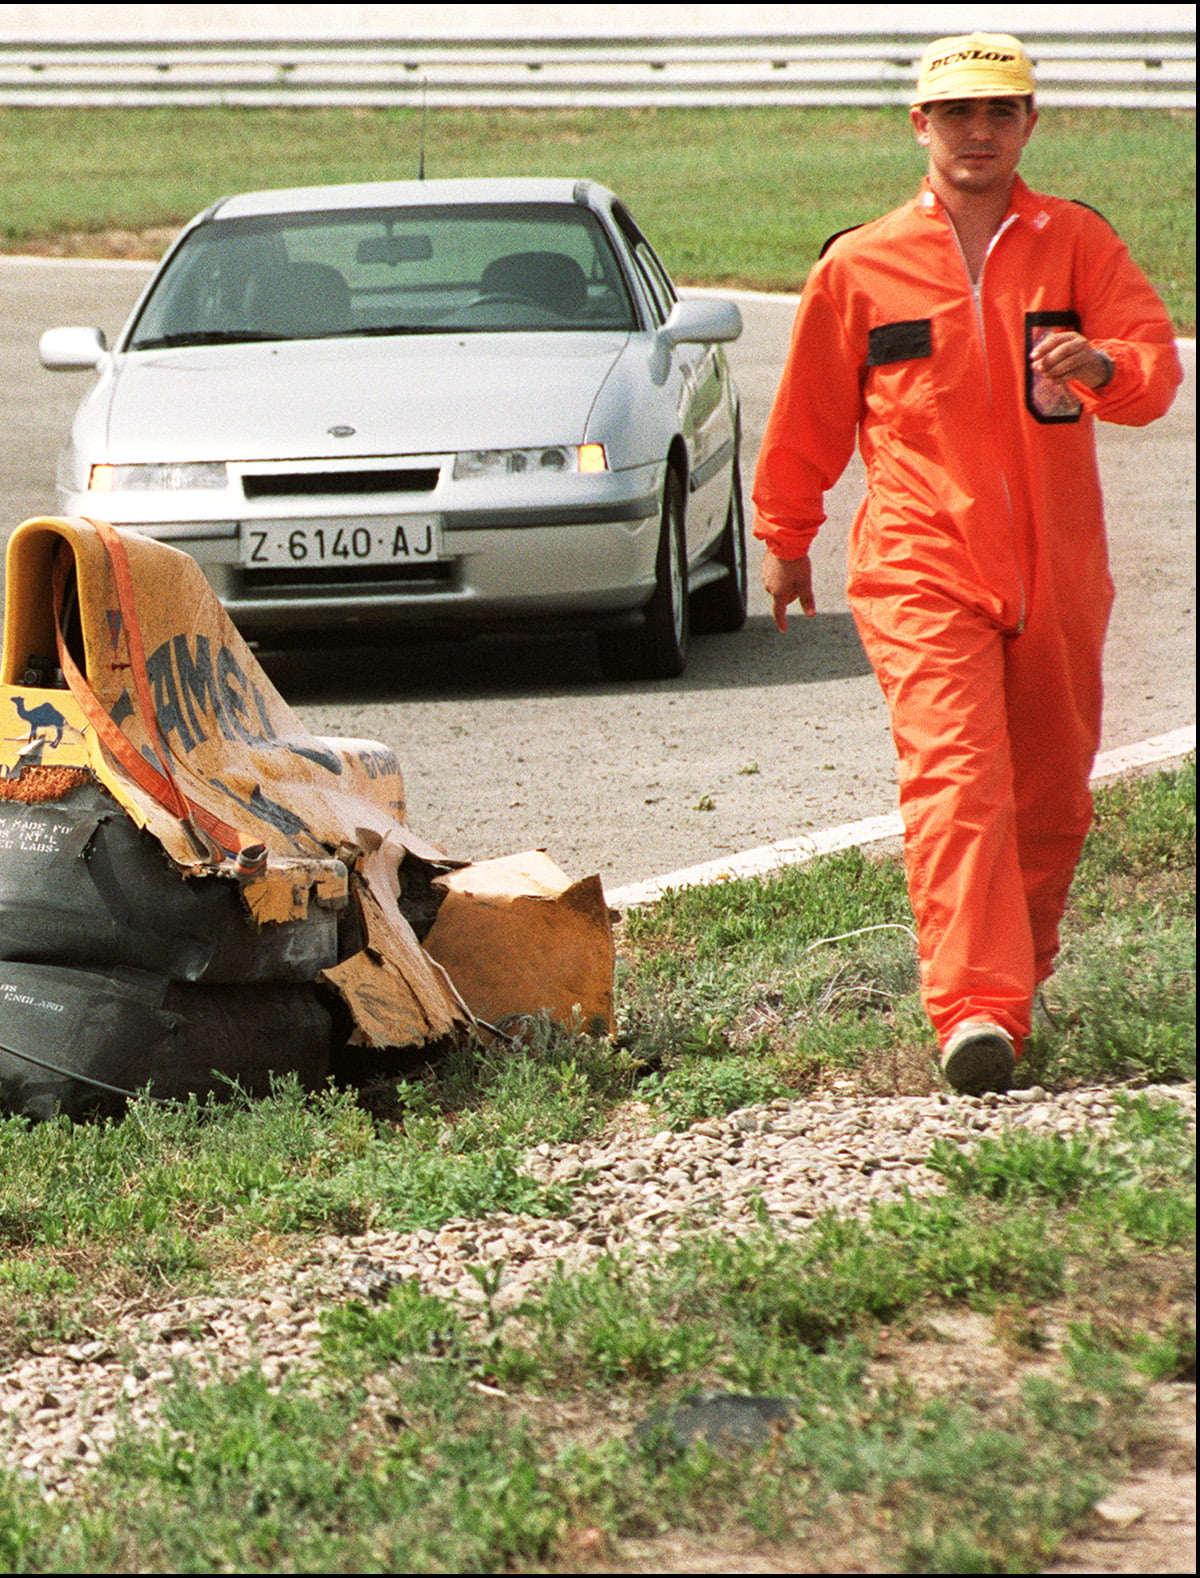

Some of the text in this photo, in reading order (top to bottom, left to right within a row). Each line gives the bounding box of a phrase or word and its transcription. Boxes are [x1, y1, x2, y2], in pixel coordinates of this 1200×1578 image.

[929, 50, 1016, 72] DUNLOP
[11, 819, 47, 833] MADE
[4, 992, 65, 1012] ENGLAND
